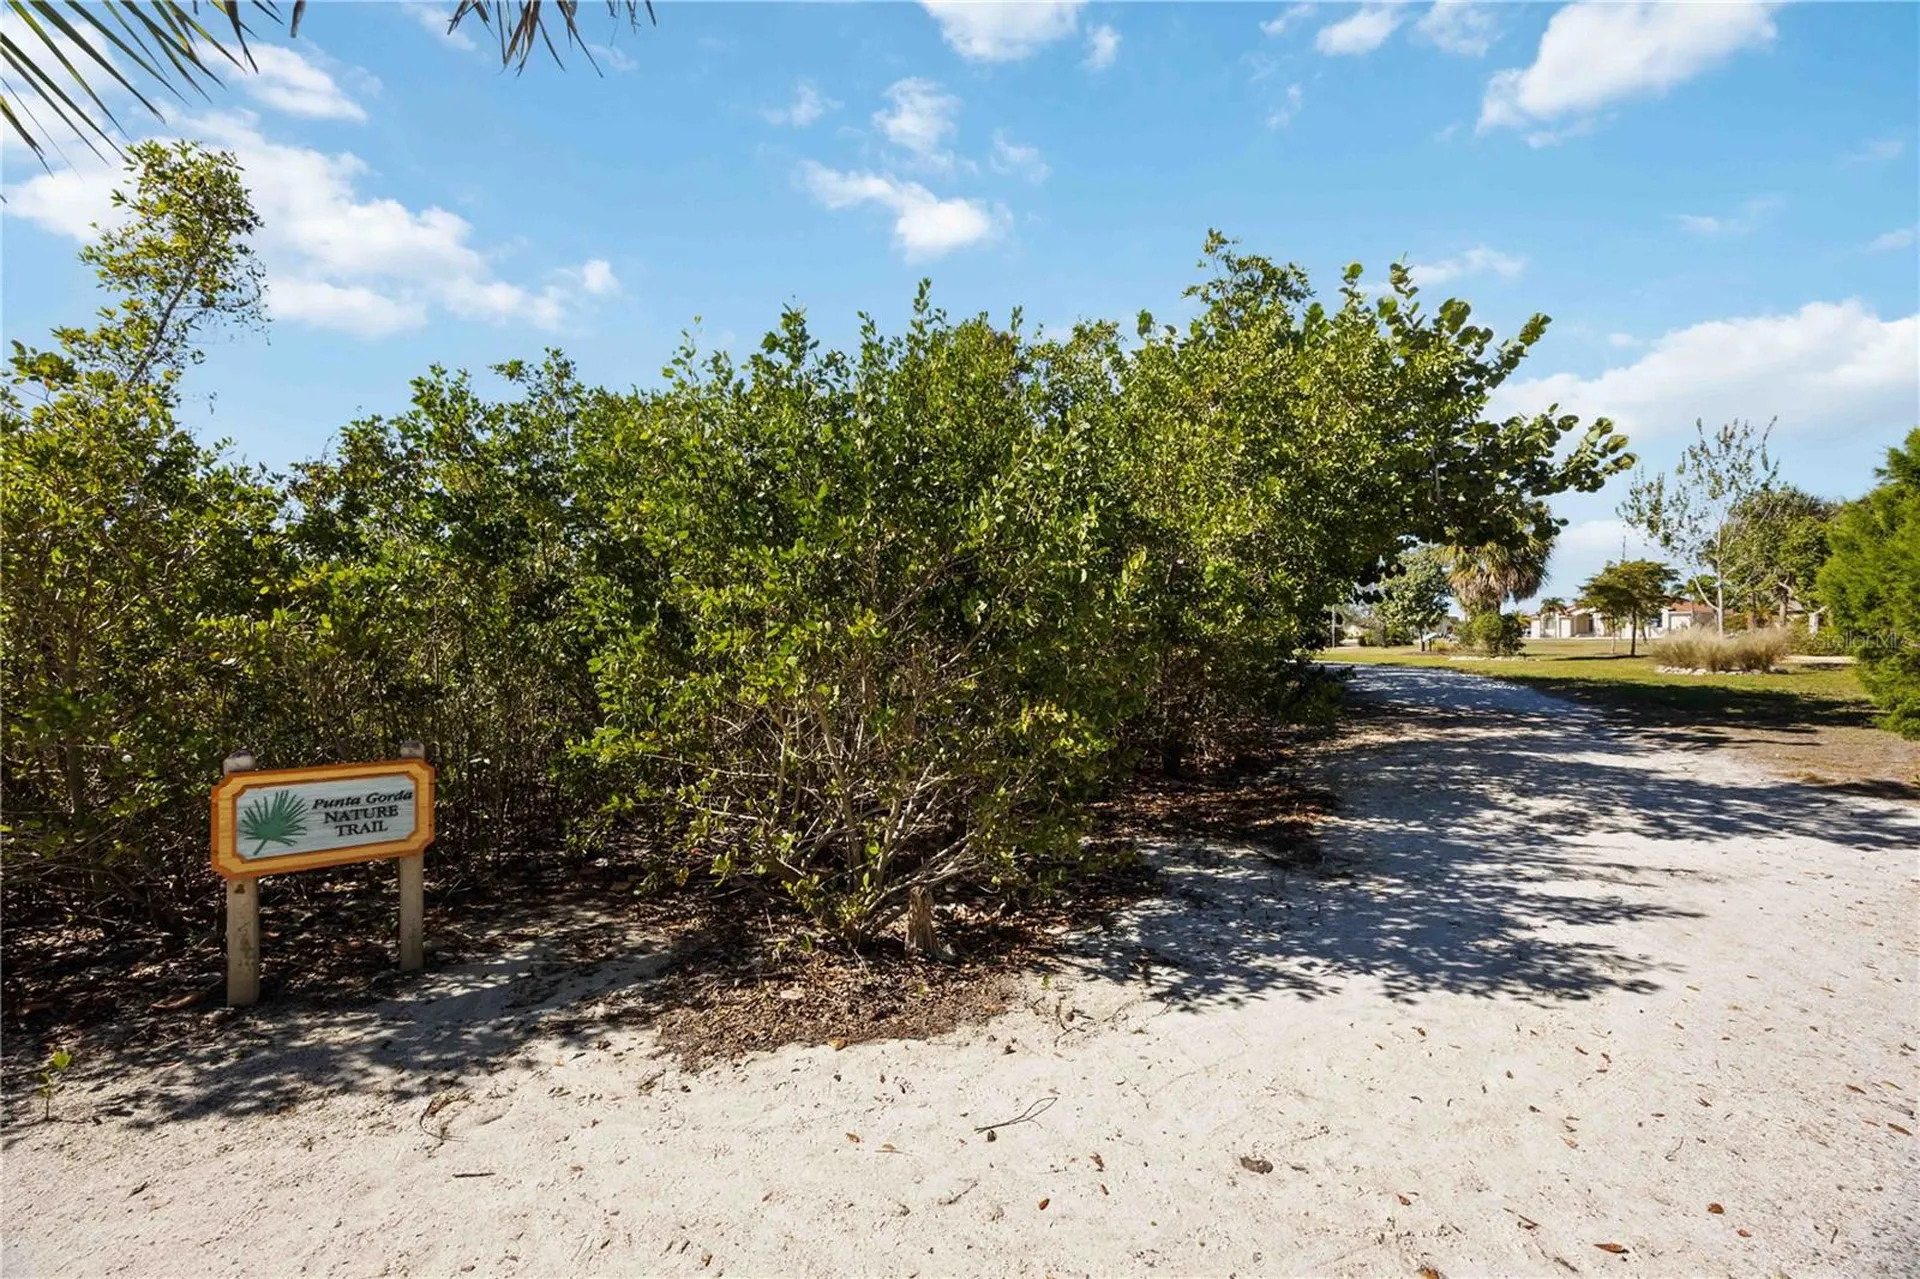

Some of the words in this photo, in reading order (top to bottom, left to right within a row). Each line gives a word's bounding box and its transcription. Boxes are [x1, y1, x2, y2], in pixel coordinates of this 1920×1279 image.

[312, 797, 361, 809] Punta
[366, 790, 412, 804] Gorda
[324, 805, 399, 824] NATURE
[335, 820, 388, 837] TRAIL
